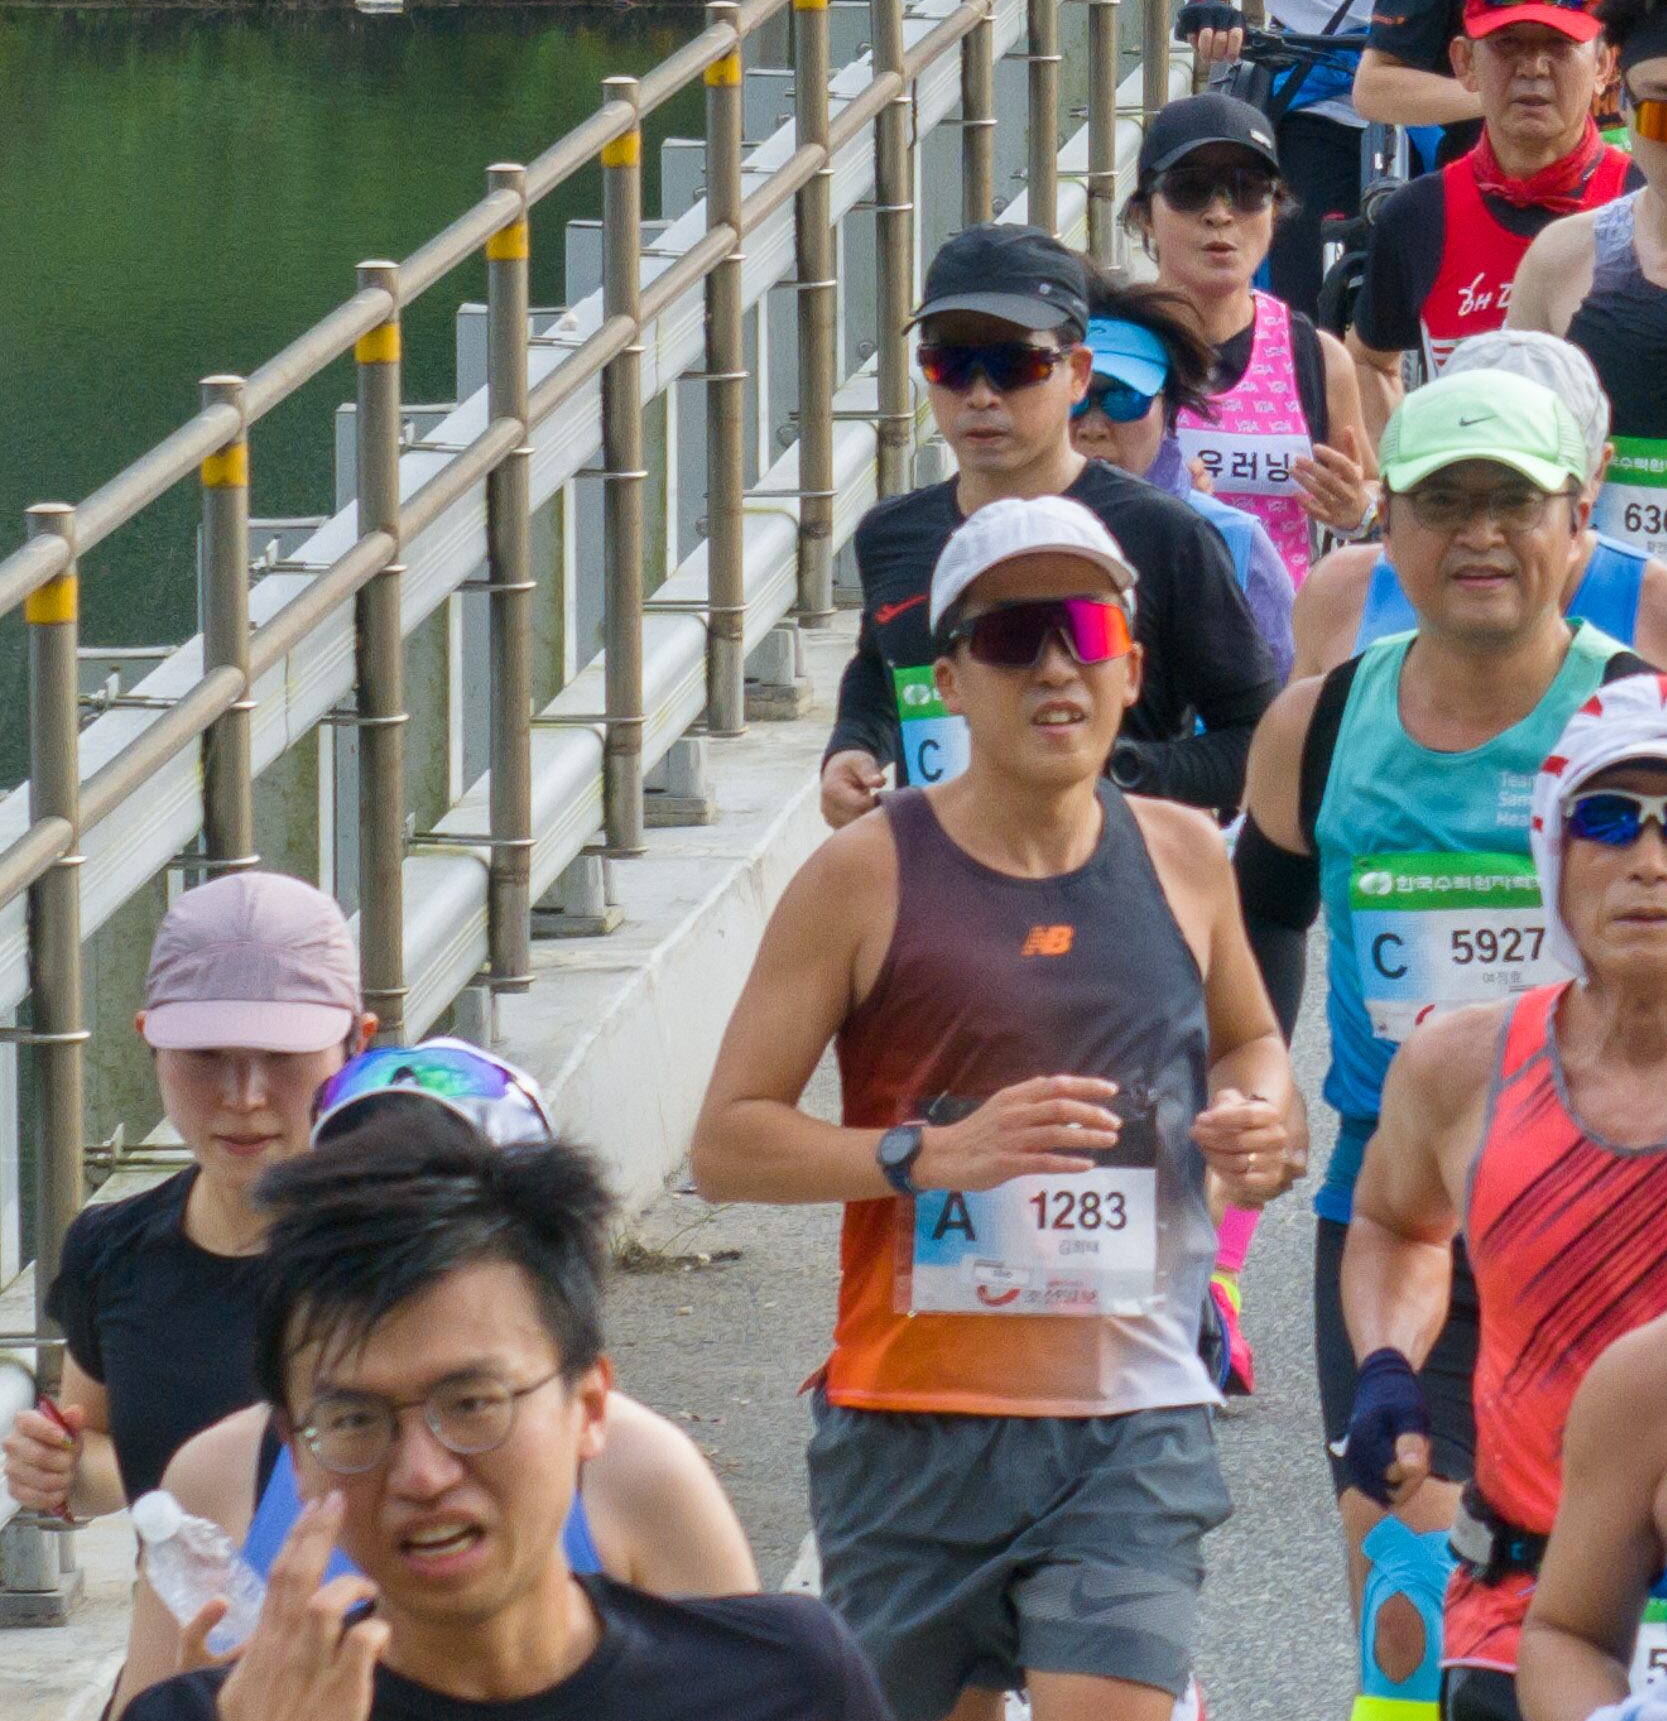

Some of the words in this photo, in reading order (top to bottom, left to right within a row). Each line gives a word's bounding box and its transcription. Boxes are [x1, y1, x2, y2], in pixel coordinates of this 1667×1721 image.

[916, 737, 943, 783] C
[1371, 932, 1408, 981] C
[1452, 927, 1545, 965] 5927
[932, 1194, 978, 1242] A
[1028, 1191, 1128, 1231] 1283
